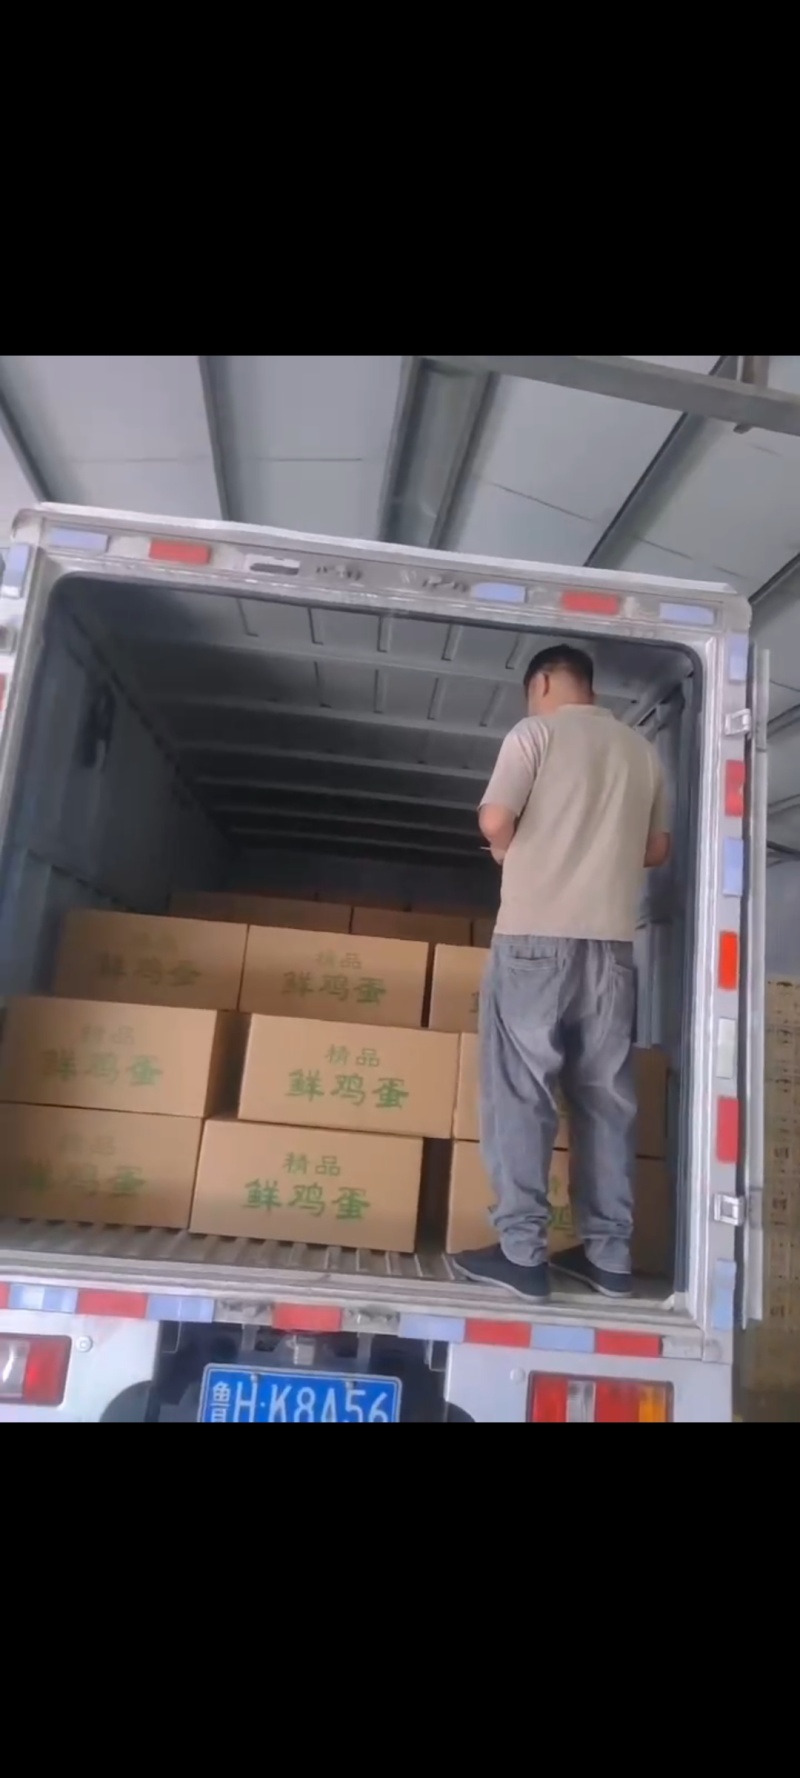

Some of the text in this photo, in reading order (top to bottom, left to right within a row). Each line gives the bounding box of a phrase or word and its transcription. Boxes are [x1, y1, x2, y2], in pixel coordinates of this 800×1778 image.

[282, 970, 387, 1005] 鲜鸡蛋
[323, 1043, 381, 1069] 精品
[285, 1068, 410, 1110] 鲜鸡蛋
[282, 1151, 342, 1178] 精品
[242, 1178, 371, 1221] 鲜鸡蛋
